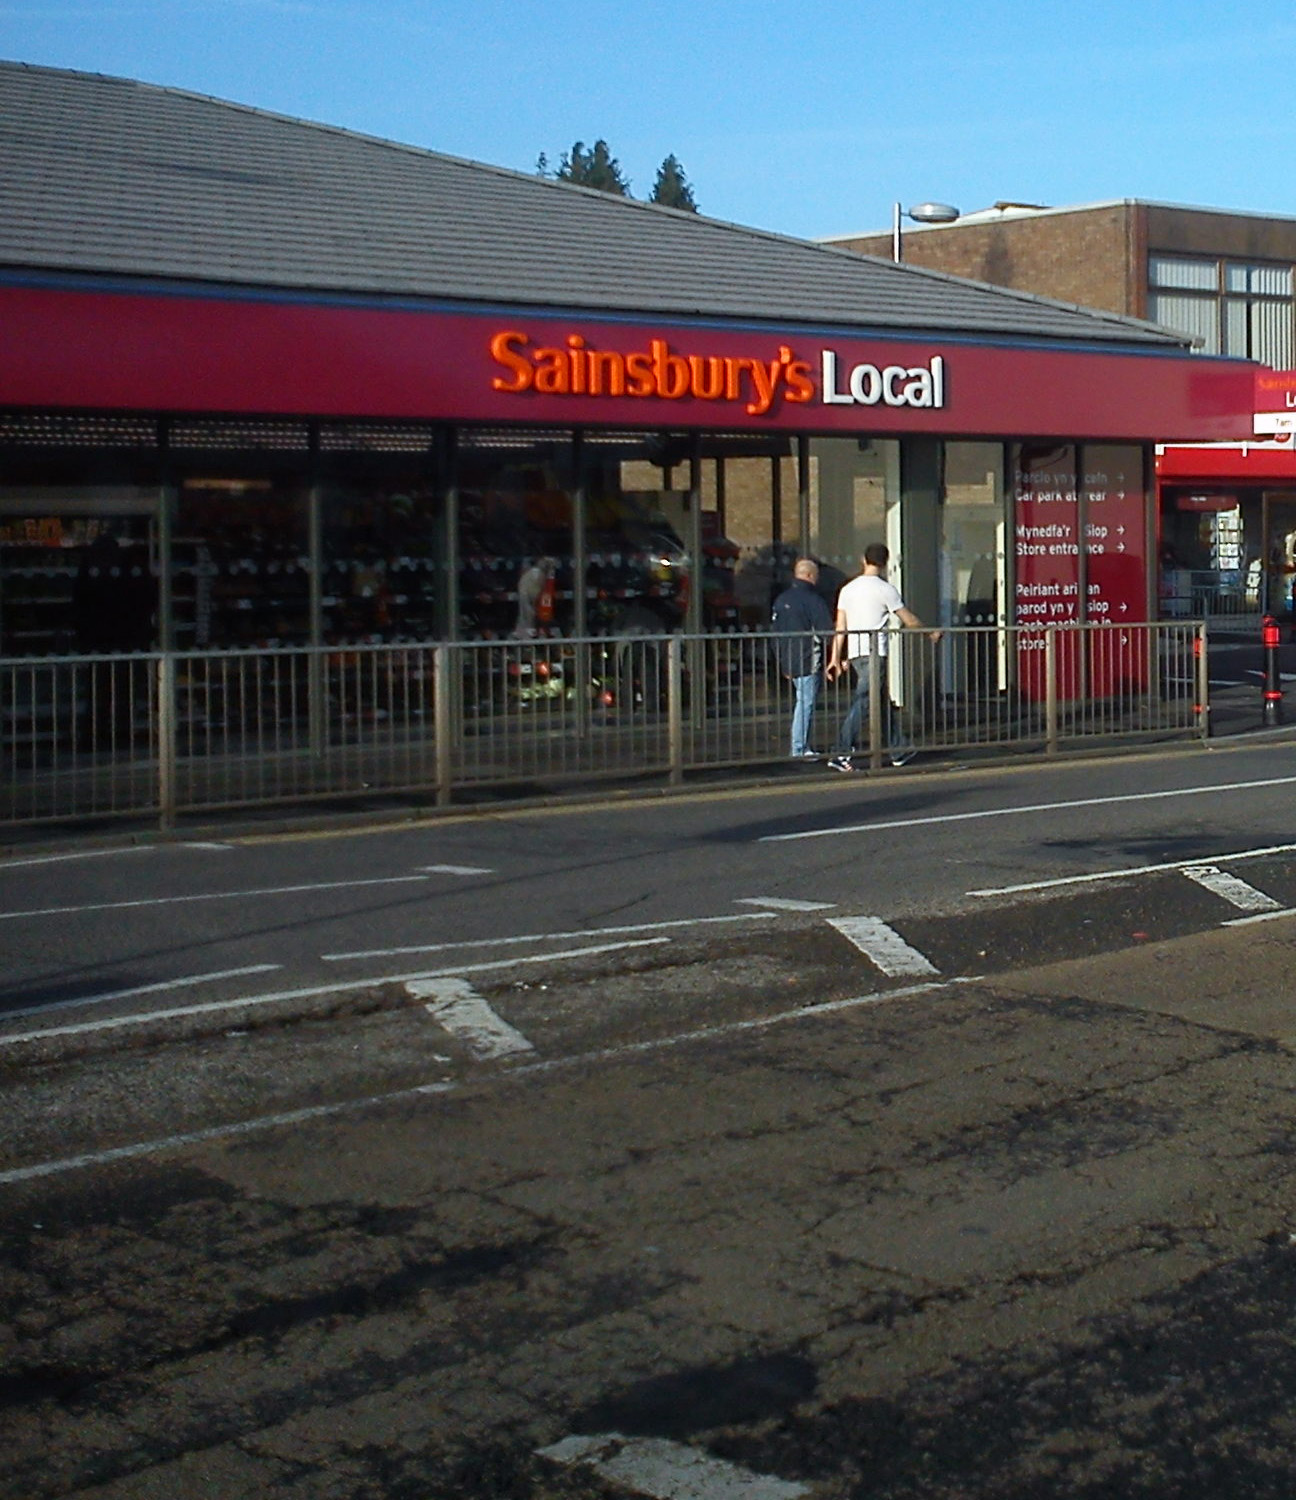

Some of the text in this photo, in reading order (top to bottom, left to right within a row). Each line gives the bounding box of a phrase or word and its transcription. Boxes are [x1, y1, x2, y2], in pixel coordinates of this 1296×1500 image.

[490, 331, 944, 415] Sainsbury's Local
[1276, 418, 1292, 427] 7am
[1015, 489, 1033, 501] Car
[1038, 490, 1062, 503] park
[1066, 491, 1077, 501] at
[1016, 523, 1108, 540] Mynedfa'r Siop
[1017, 541, 1047, 556] Store
[1016, 582, 1060, 596] Peiriant
[1016, 600, 1109, 616] parod yn y siop
